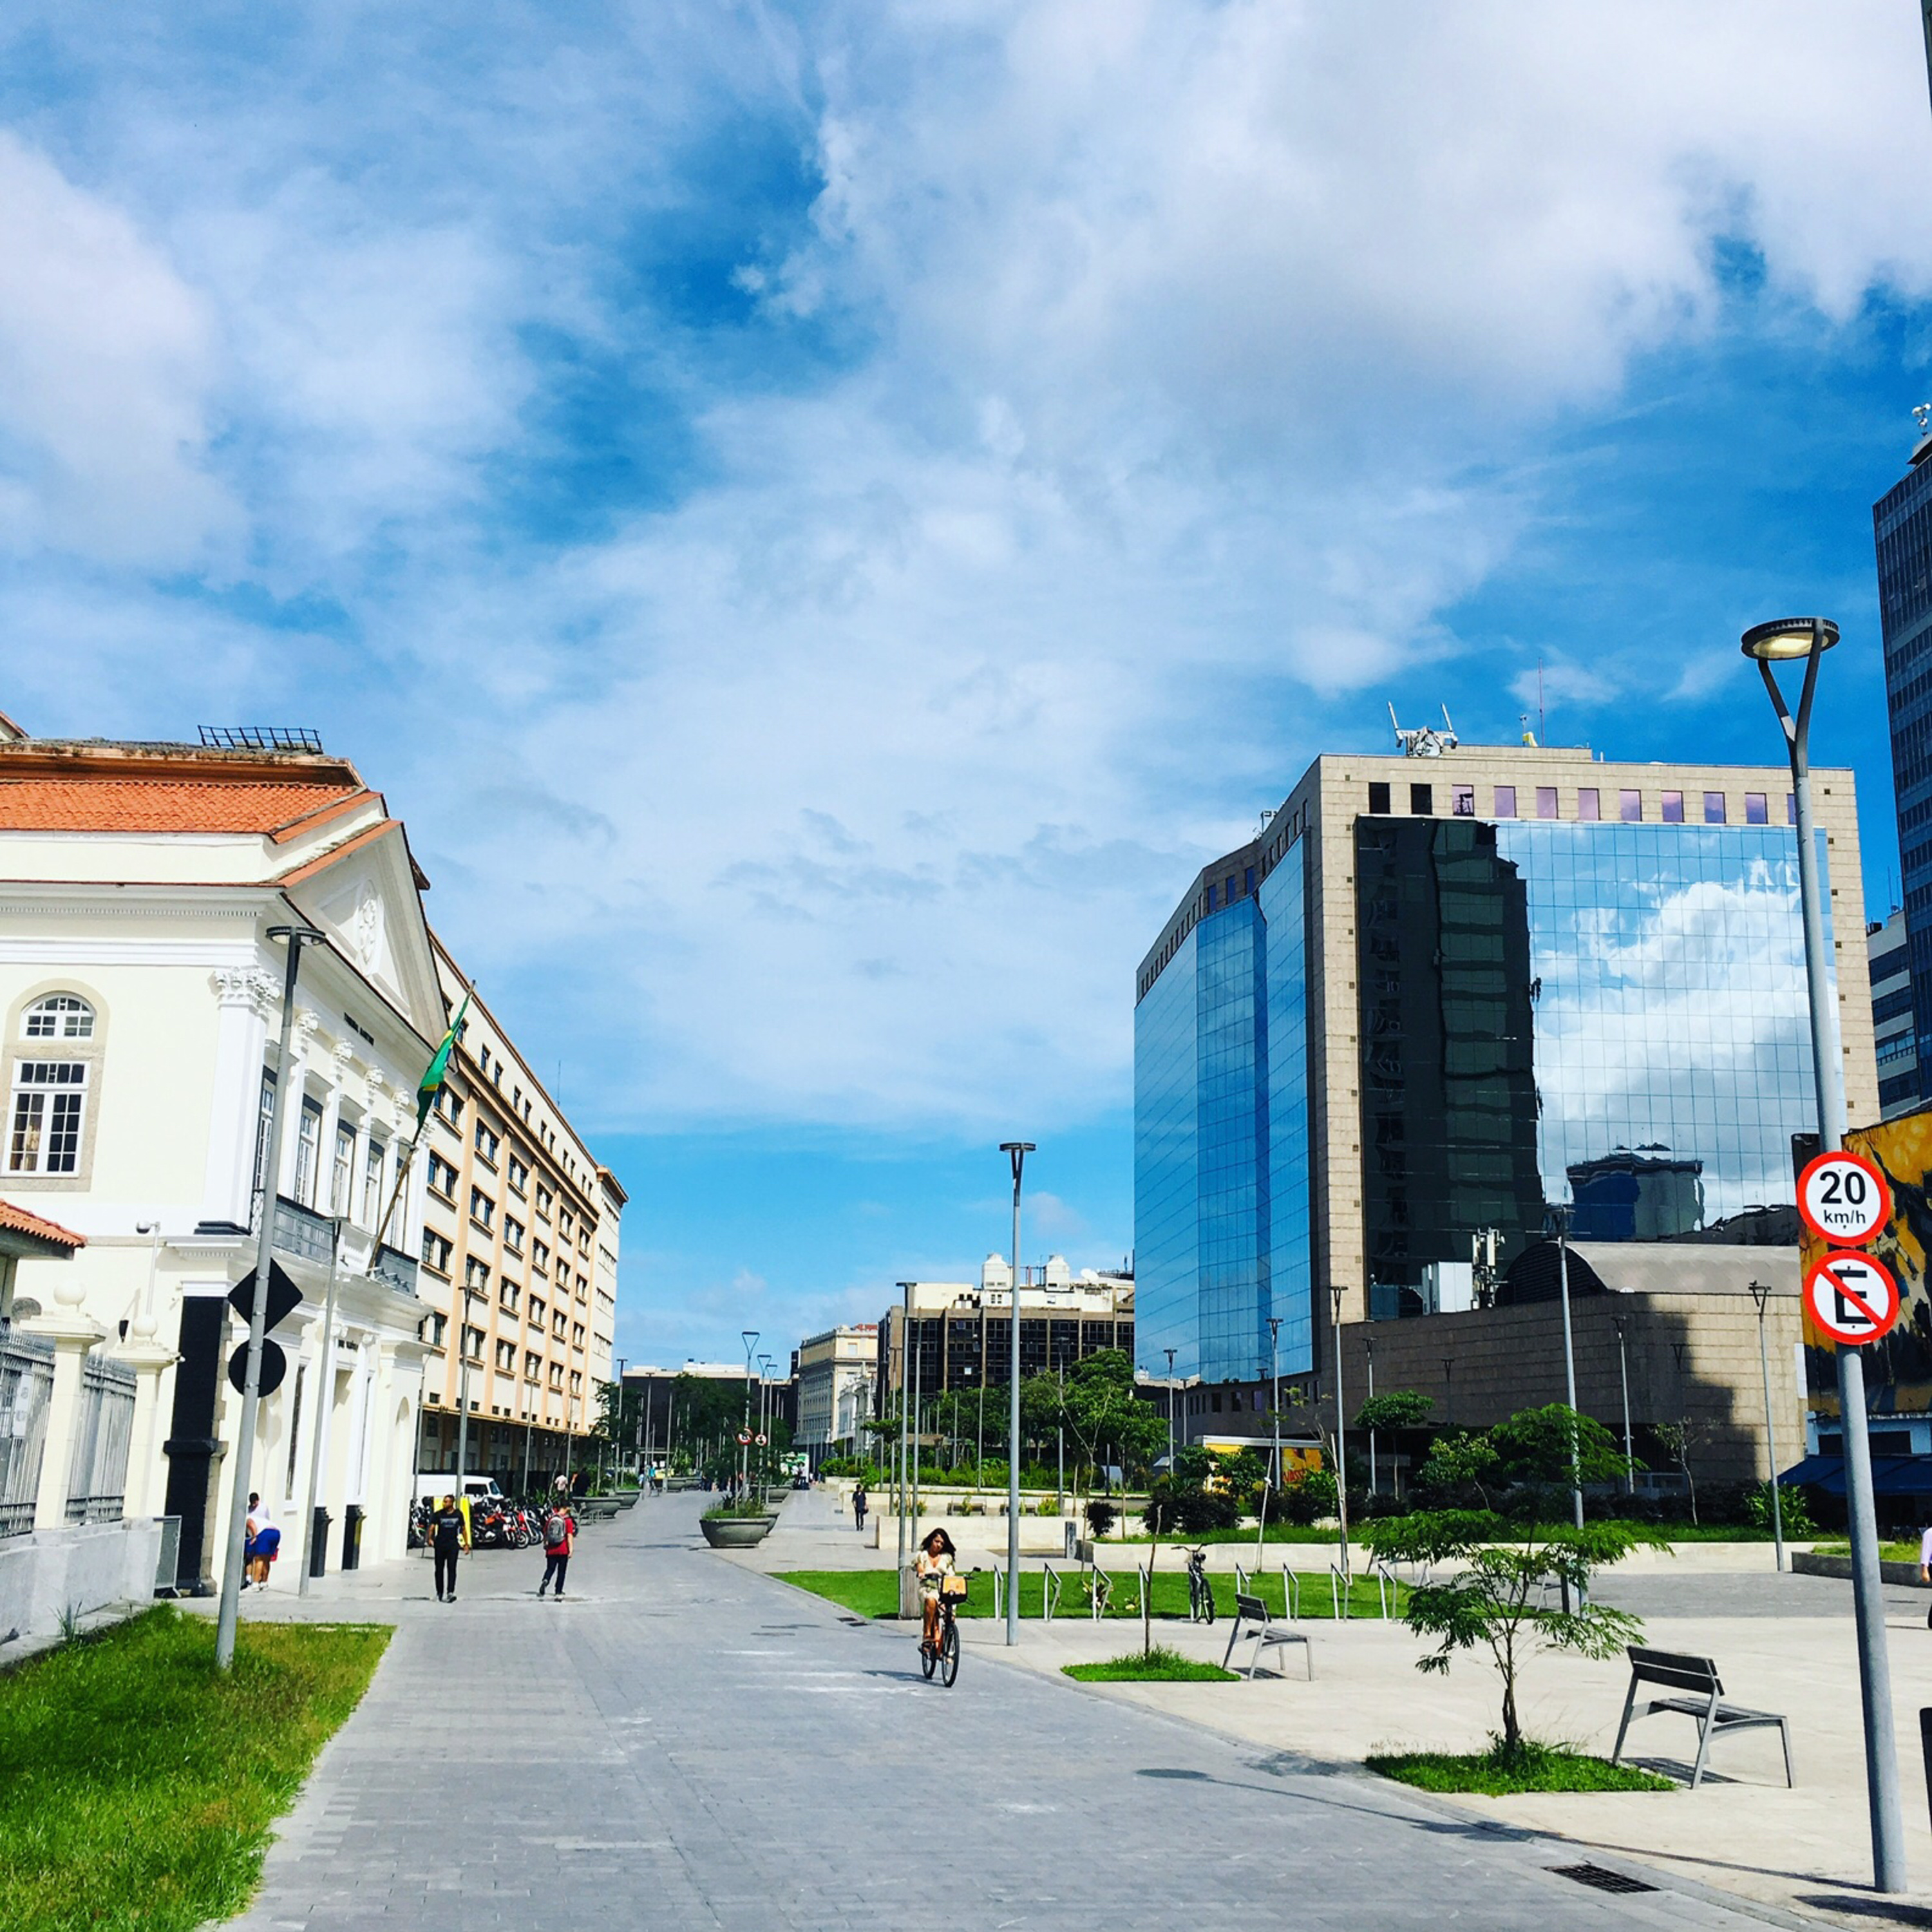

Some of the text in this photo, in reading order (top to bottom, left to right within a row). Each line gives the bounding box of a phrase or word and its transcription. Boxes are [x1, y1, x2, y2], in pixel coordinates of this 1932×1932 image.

[1819, 1171, 1866, 1204] 20
[1824, 1209, 1866, 1224] km/h
[1833, 1269, 1871, 1324] E
